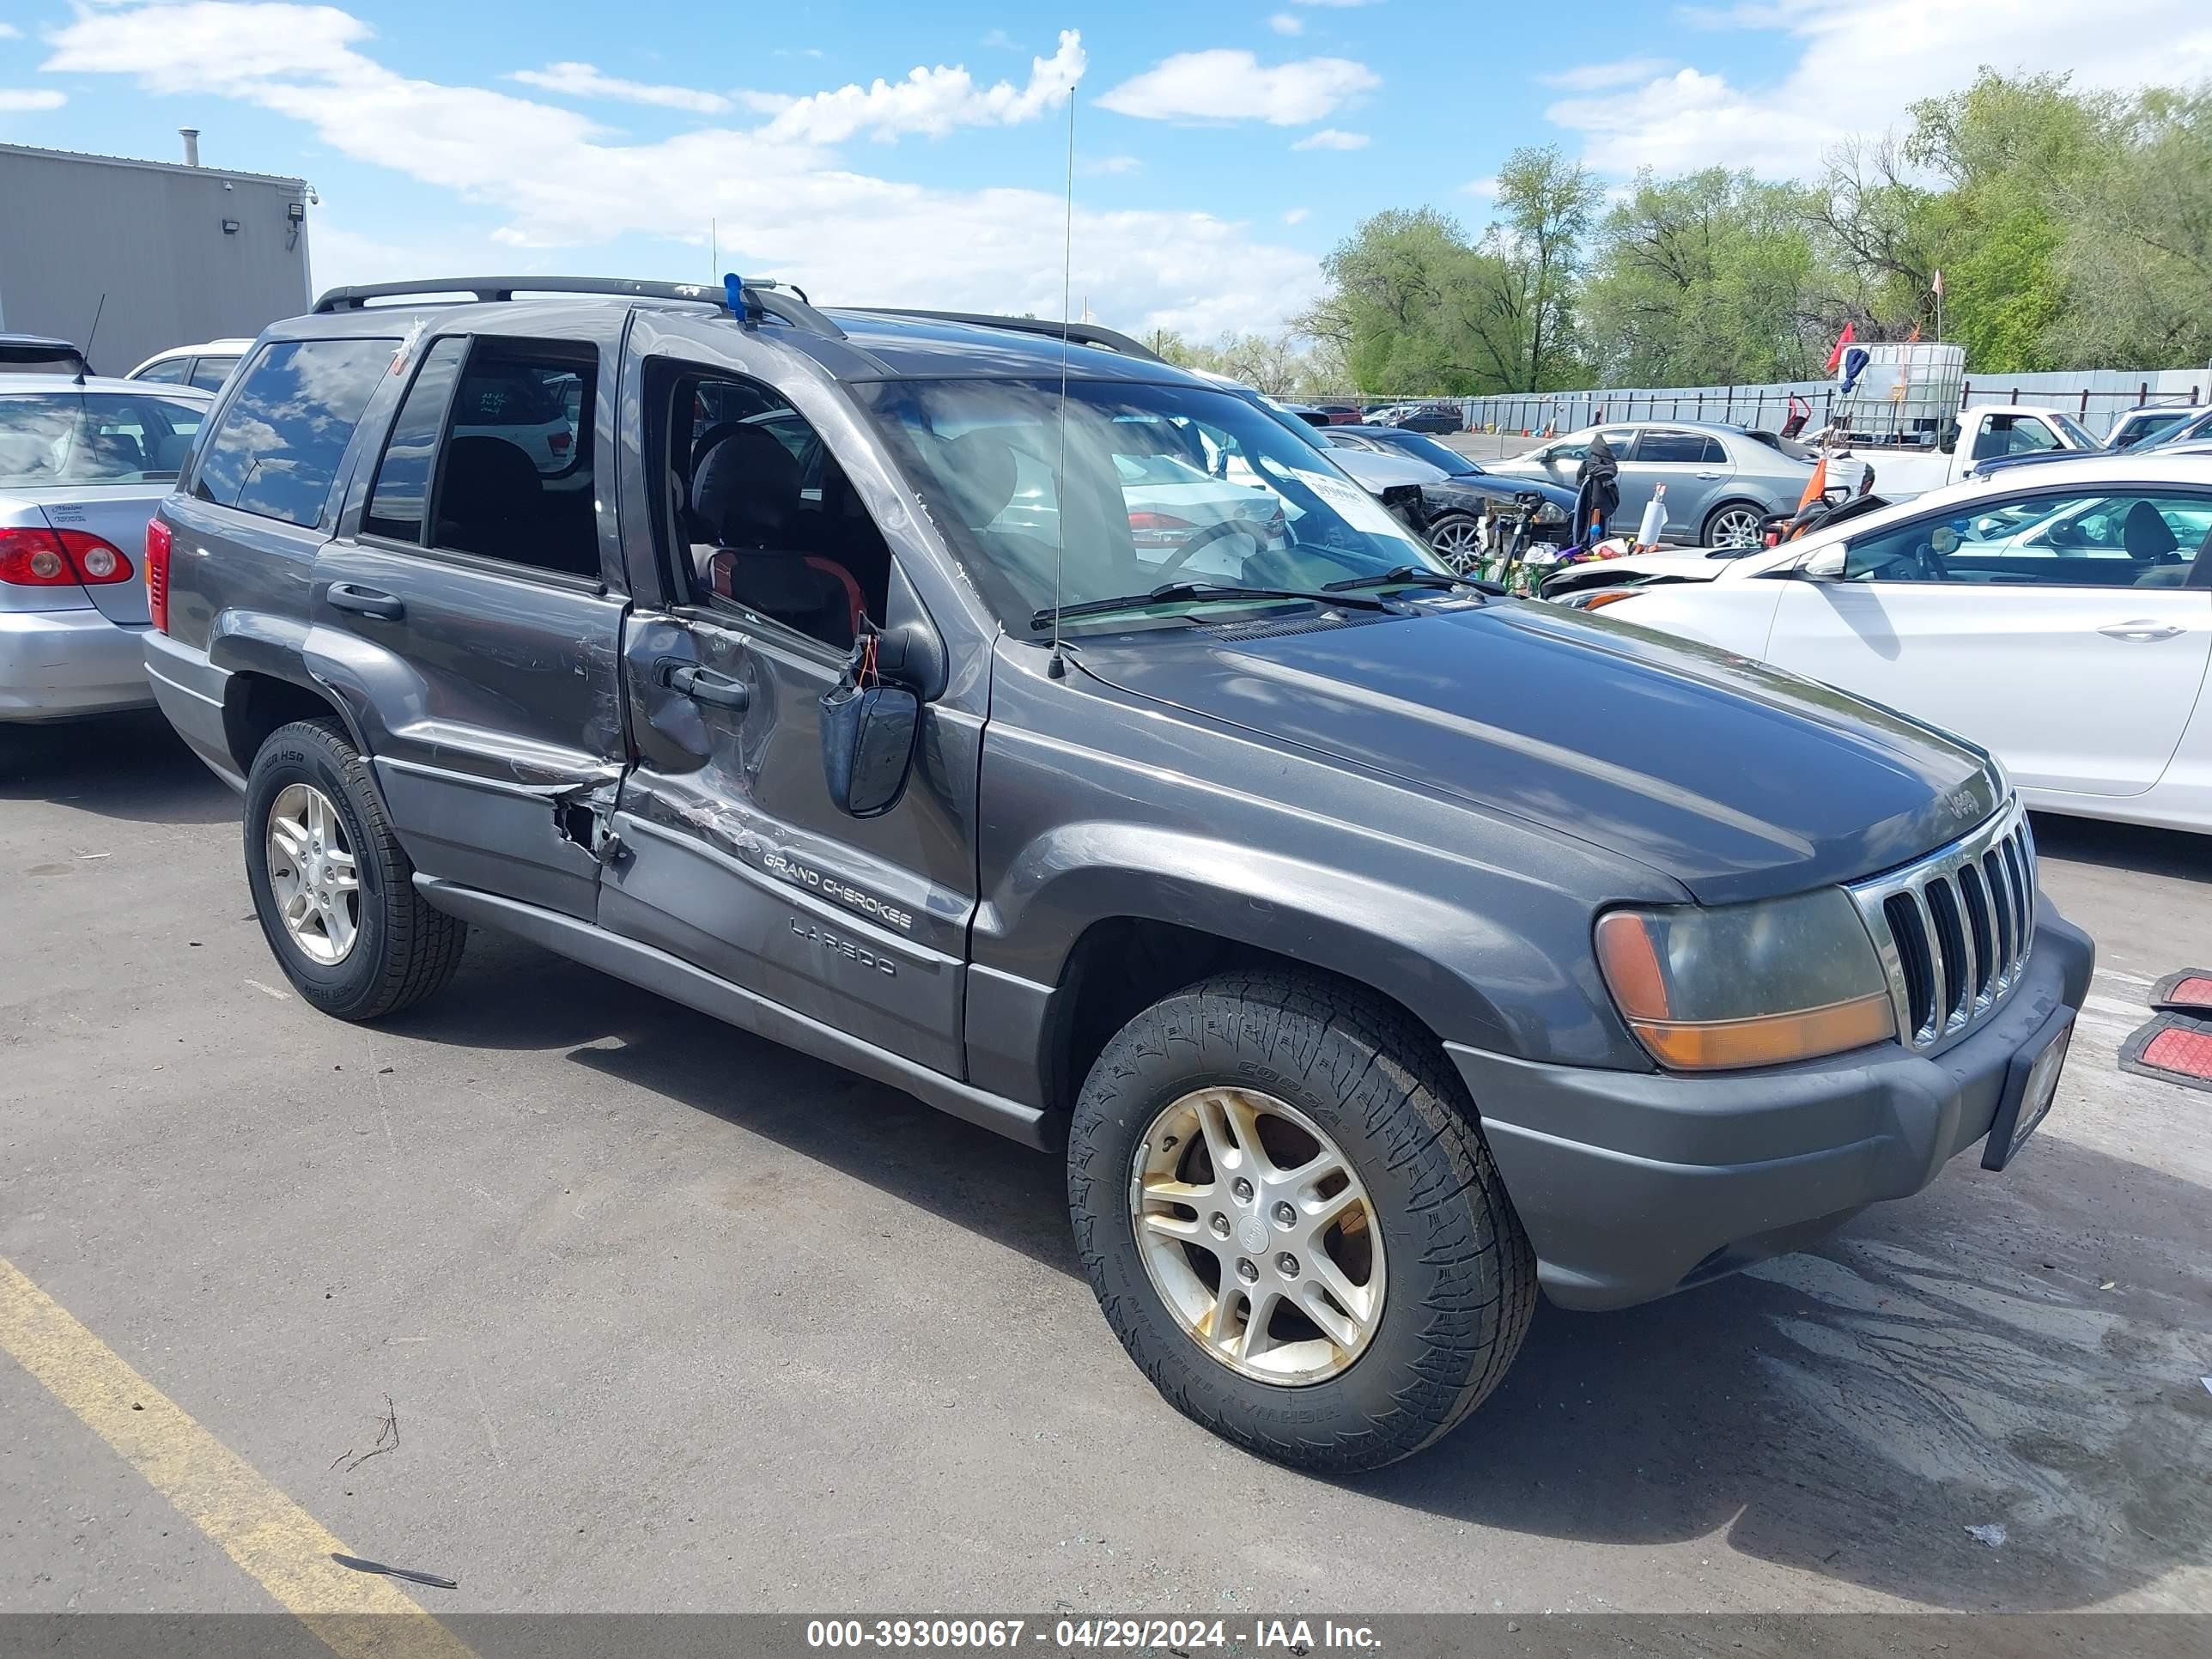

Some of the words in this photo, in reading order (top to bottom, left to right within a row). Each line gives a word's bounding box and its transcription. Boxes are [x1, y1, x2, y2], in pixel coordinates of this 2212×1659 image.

[1944, 789, 1980, 819] Jeep
[763, 853, 819, 887] GRAND
[822, 878, 913, 930] CHEROKEE
[789, 916, 898, 978] LAREDO
